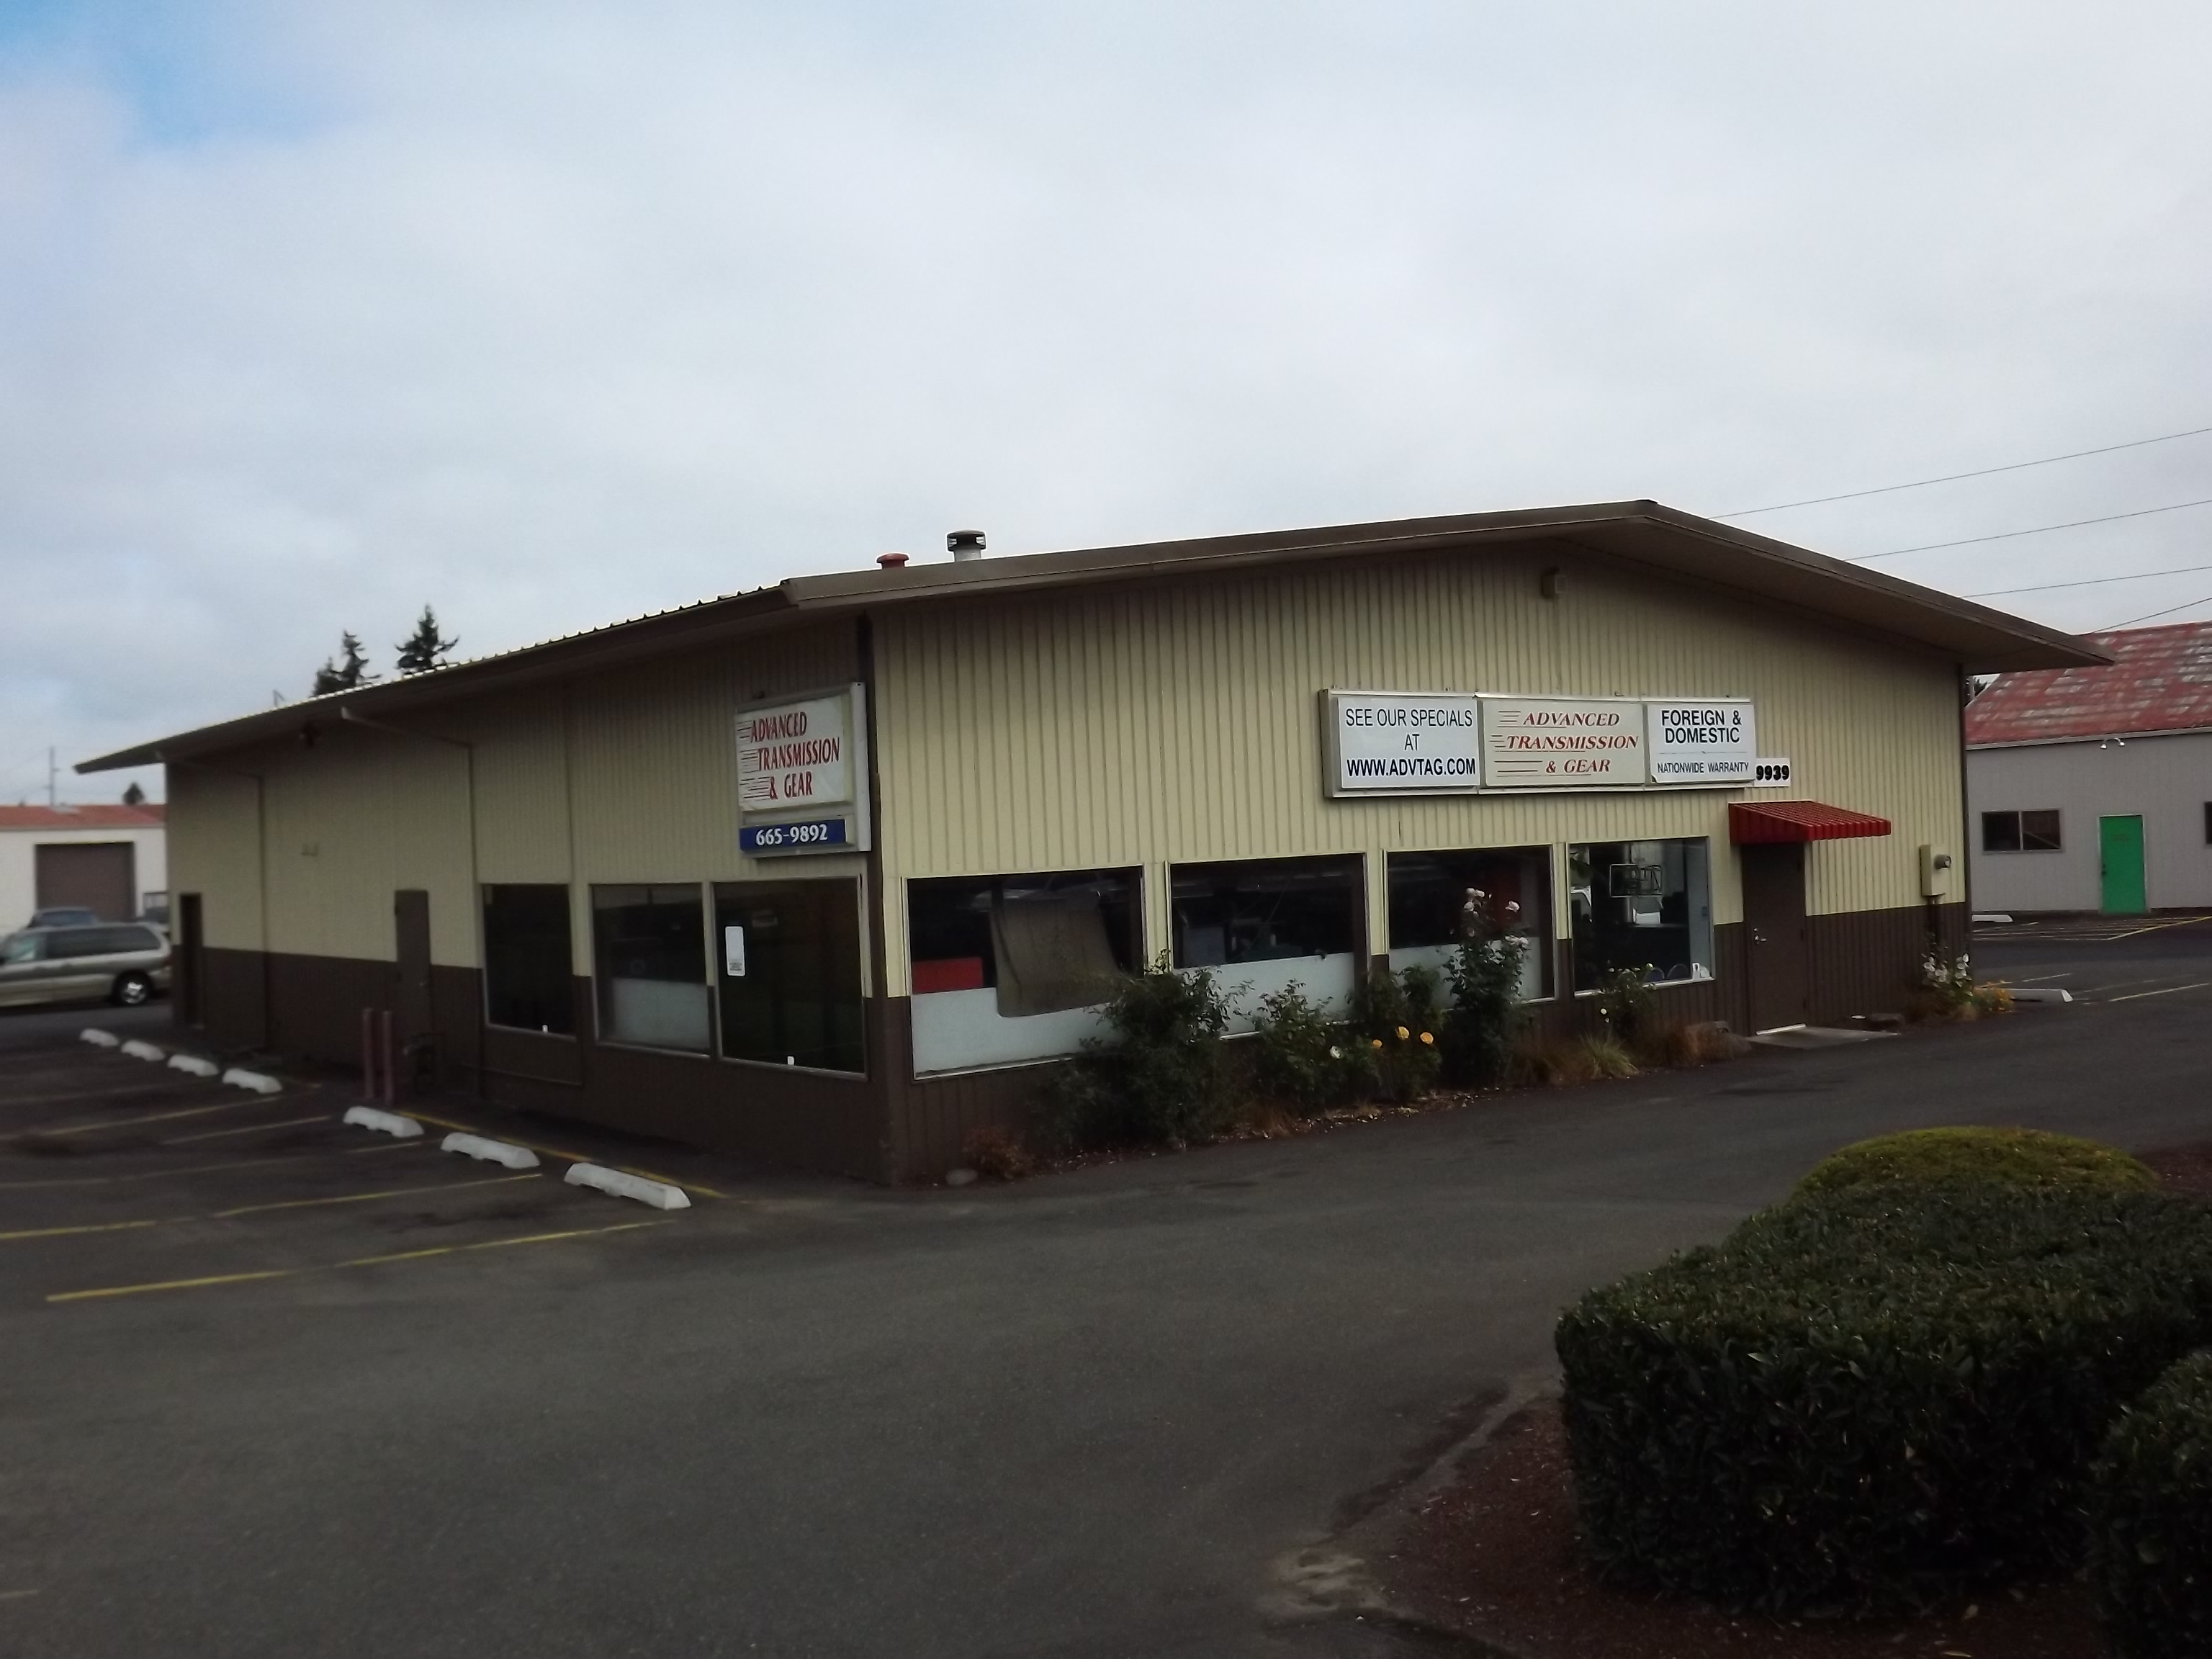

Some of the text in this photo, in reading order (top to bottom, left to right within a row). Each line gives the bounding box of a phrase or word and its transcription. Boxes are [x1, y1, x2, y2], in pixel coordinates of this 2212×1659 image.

[1346, 709, 1473, 727] SEE OUR SPECIALS
[1523, 712, 1620, 726] ADVANCED
[1661, 709, 1742, 726] FOREIGN &
[750, 711, 807, 742] ADVANCED
[1665, 727, 1740, 743] DOMESTIC
[1405, 733, 1420, 751] AT
[1507, 735, 1639, 750] TRANSMISSION
[757, 737, 840, 772] TRANSMISSION
[1346, 757, 1476, 777] WWW.ADVTAG.COM
[1546, 759, 1611, 773] & GEAR
[1657, 761, 1749, 773] NATIONWIDE WARRANTY
[1755, 765, 1789, 781] 9939
[770, 771, 813, 800] & GEAR
[755, 823, 828, 846] 665-9892
